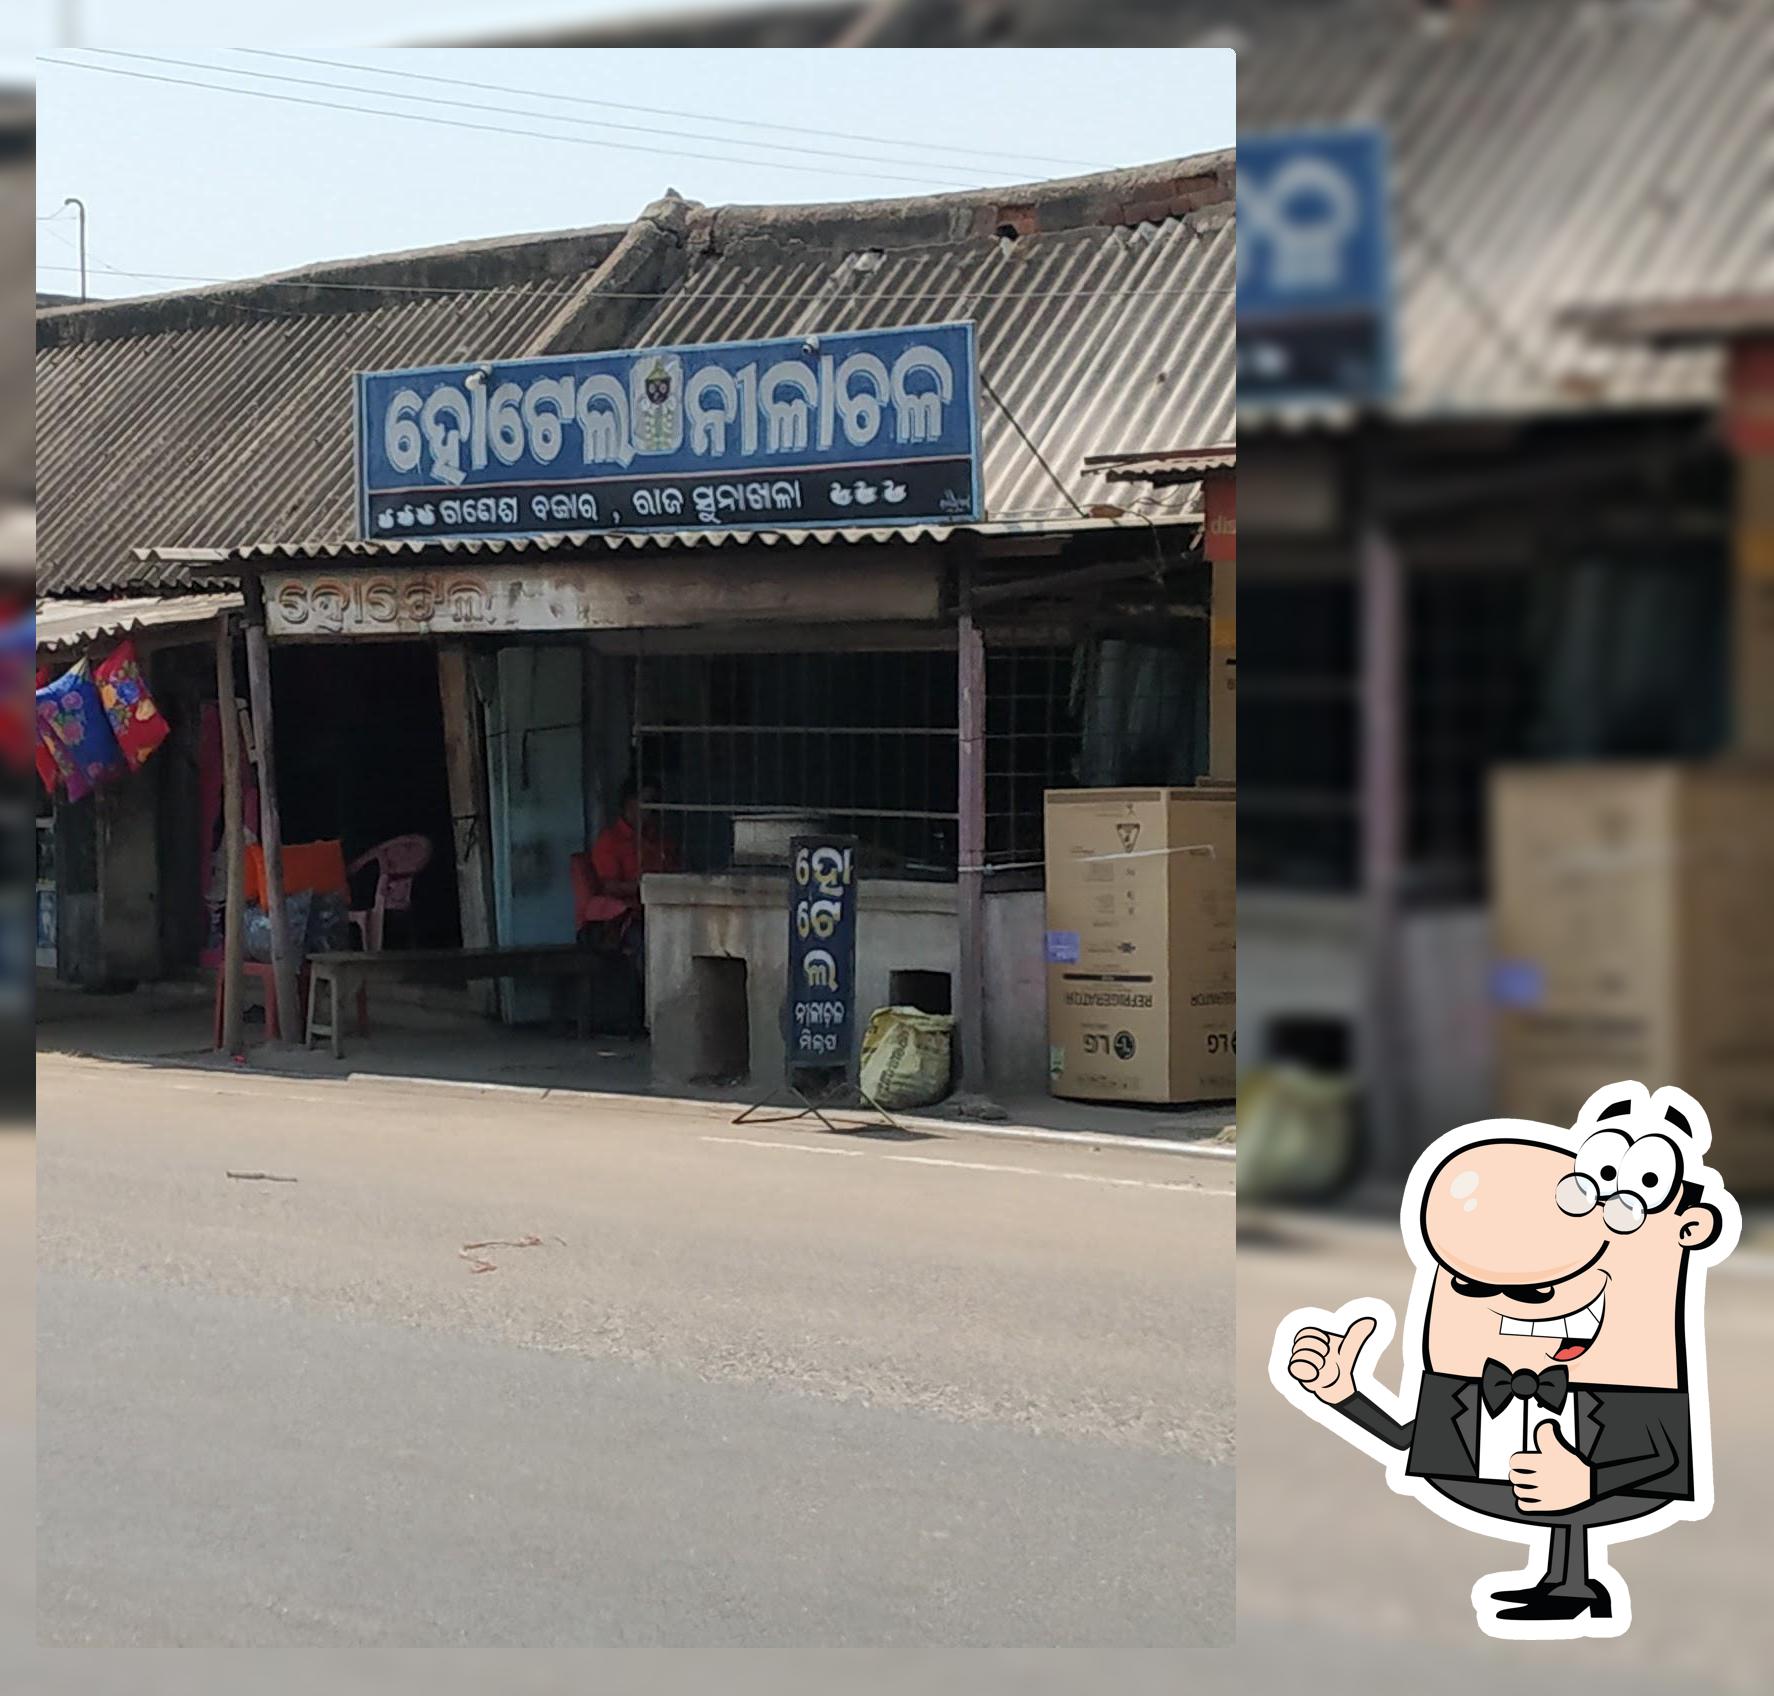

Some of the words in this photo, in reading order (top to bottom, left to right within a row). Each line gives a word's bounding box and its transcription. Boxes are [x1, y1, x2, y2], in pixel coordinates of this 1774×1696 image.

[384, 373, 636, 486] ହୋଟେଲ
[684, 345, 953, 457] ନୀଳାଚଳ
[439, 496, 518, 524] ଗଣେଶ
[632, 487, 684, 516] ରାଜ
[693, 479, 802, 524] ସୁନାଖଳା
[1066, 992, 1153, 1008] REFRIGERATOR
[1083, 1034, 1111, 1055] LG
[1207, 1034, 1229, 1054] LG
